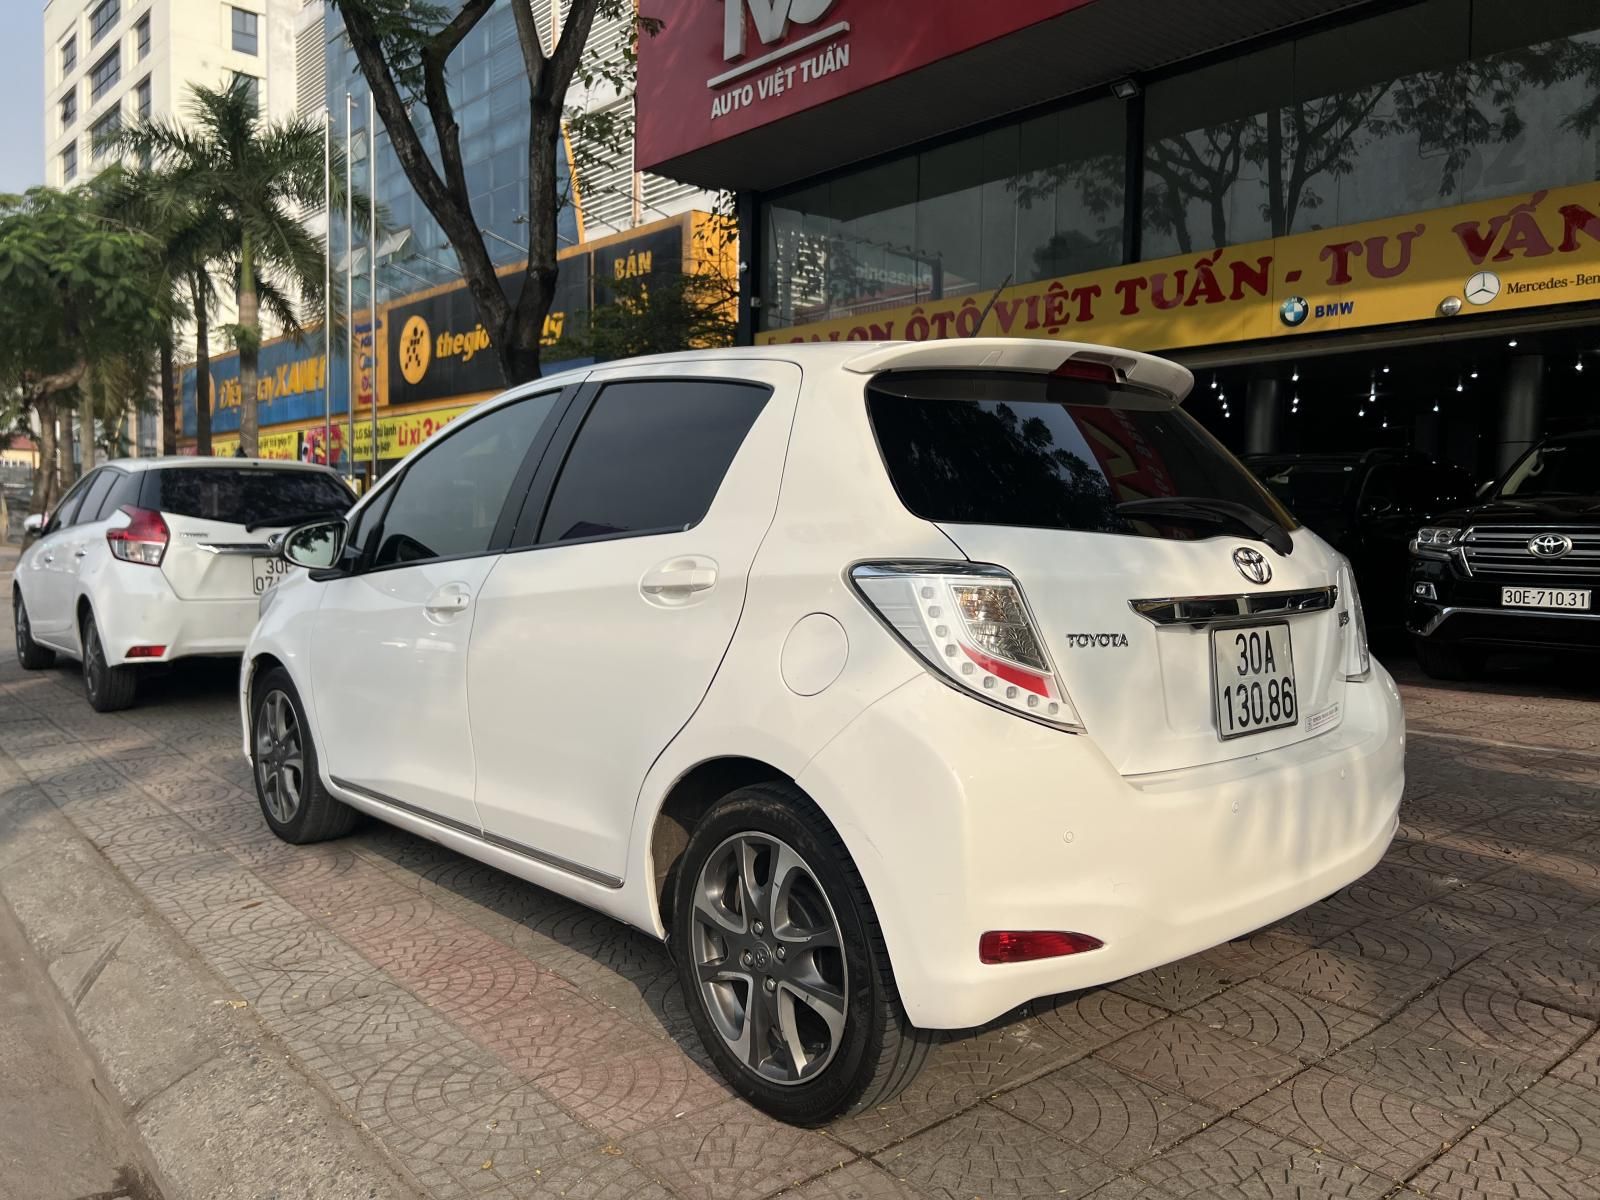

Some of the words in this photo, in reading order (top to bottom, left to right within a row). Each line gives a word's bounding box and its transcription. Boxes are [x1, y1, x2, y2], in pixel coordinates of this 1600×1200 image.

[711, 84, 753, 119] AUTO
[758, 66, 796, 99] VIỆT
[800, 43, 849, 83] TUẤN
[614, 249, 652, 281] BÁN
[994, 281, 1101, 334] VIỆT
[1115, 249, 1273, 316] TUẤN
[1320, 224, 1426, 286] TƯ
[1452, 190, 1600, 265] VẤN
[1315, 301, 1354, 318] BMW
[1505, 589, 1585, 607] 30E-710.31
[1066, 633, 1128, 648] TOYOTA
[1236, 630, 1276, 676] 30A
[1224, 677, 1294, 730] 130.86
